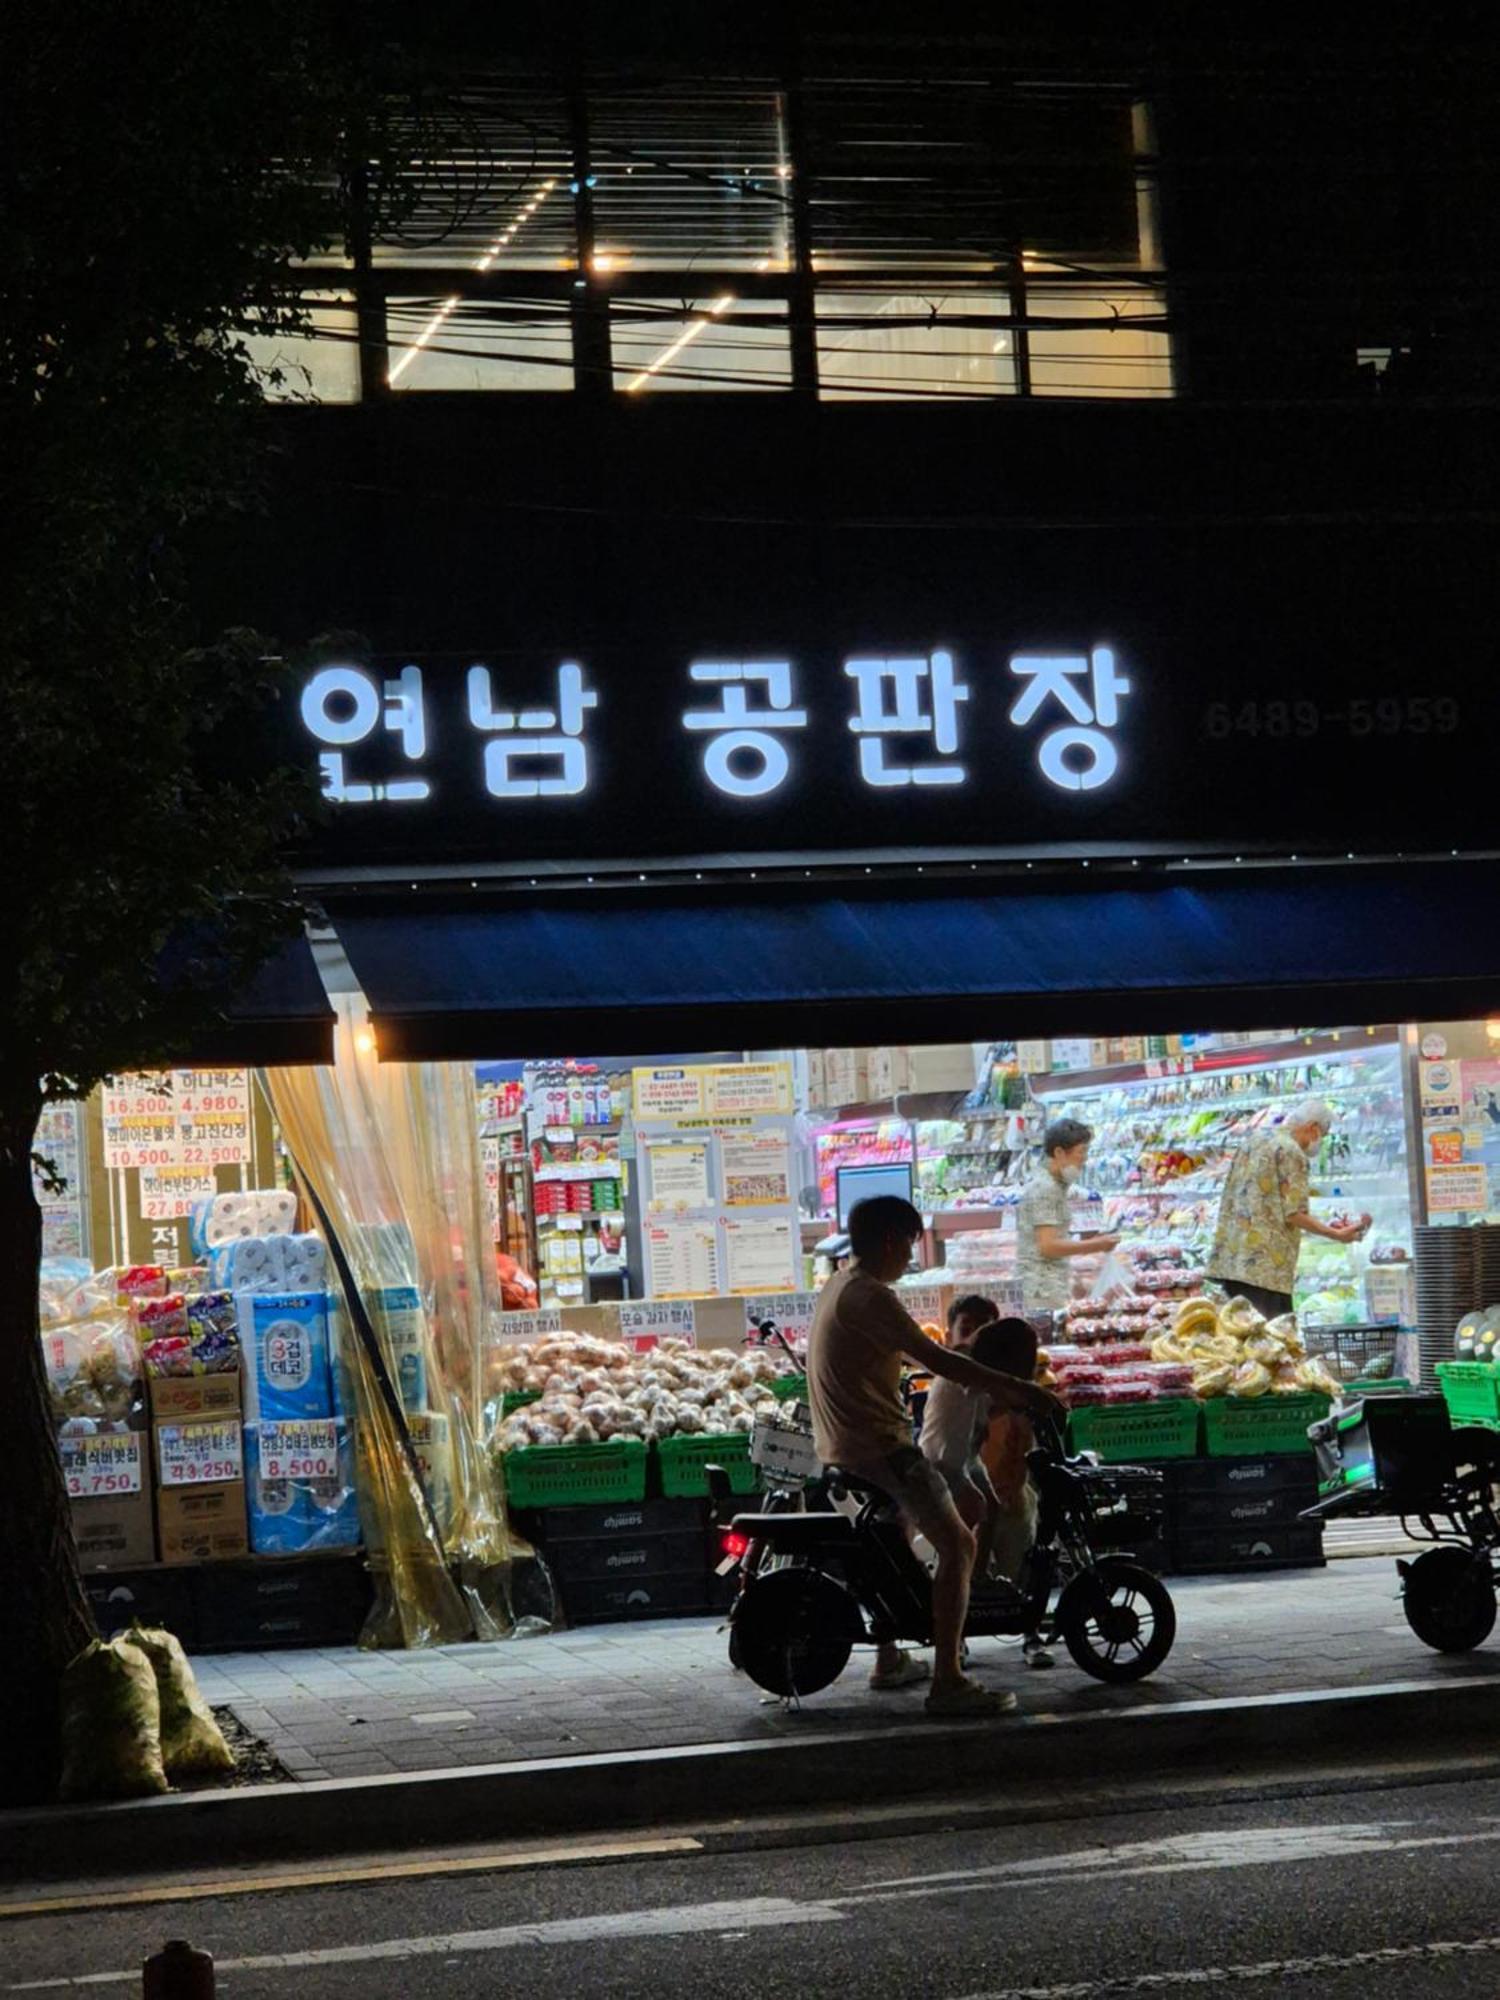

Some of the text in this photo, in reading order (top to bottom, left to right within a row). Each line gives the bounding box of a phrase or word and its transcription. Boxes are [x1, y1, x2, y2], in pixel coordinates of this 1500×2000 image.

[300, 647, 1131, 802] 연남 공판장
[1205, 697, 1460, 737] 6489-5959
